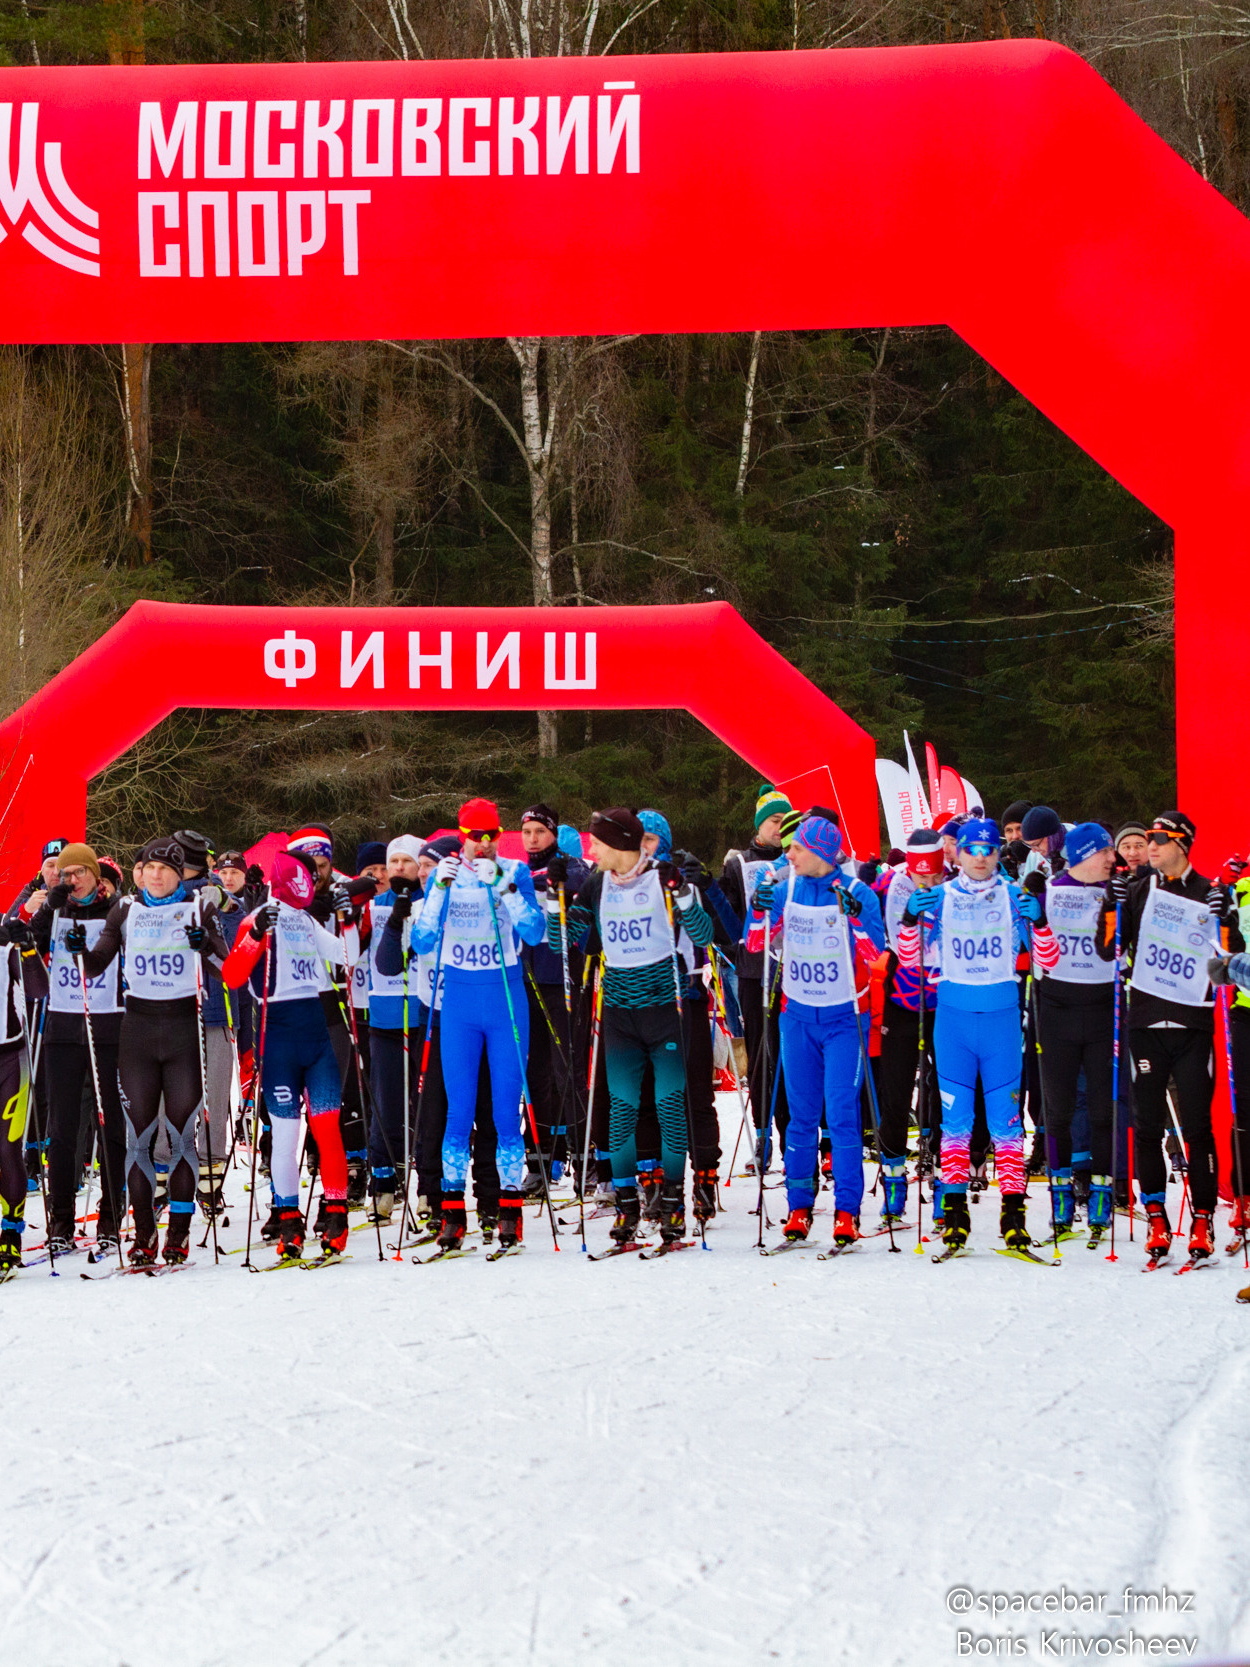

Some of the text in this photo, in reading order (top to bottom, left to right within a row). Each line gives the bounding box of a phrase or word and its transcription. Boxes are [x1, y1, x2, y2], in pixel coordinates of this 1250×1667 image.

[138, 81, 641, 180] МОСКОВСКИЙ
[139, 189, 372, 278] СПОРТ
[264, 630, 597, 690] ФИНИШ
[450, 909, 480, 918] РОССИИ
[1053, 900, 1084, 909] РОССИИ
[1053, 909, 1083, 920] 2023
[451, 918, 479, 928] 2023
[1150, 916, 1180, 934] 2023
[1153, 909, 1183, 923] РОССИИ
[133, 928, 161, 939] 2023
[607, 916, 653, 943] 3667
[452, 943, 501, 967] 9486
[952, 936, 1003, 960] 9048
[134, 953, 185, 976] 9159
[790, 960, 839, 984] 9083
[965, 966, 990, 974] МОСКВА
[1145, 944, 1197, 980] 3986
[1154, 976, 1178, 988] МОСКВА
